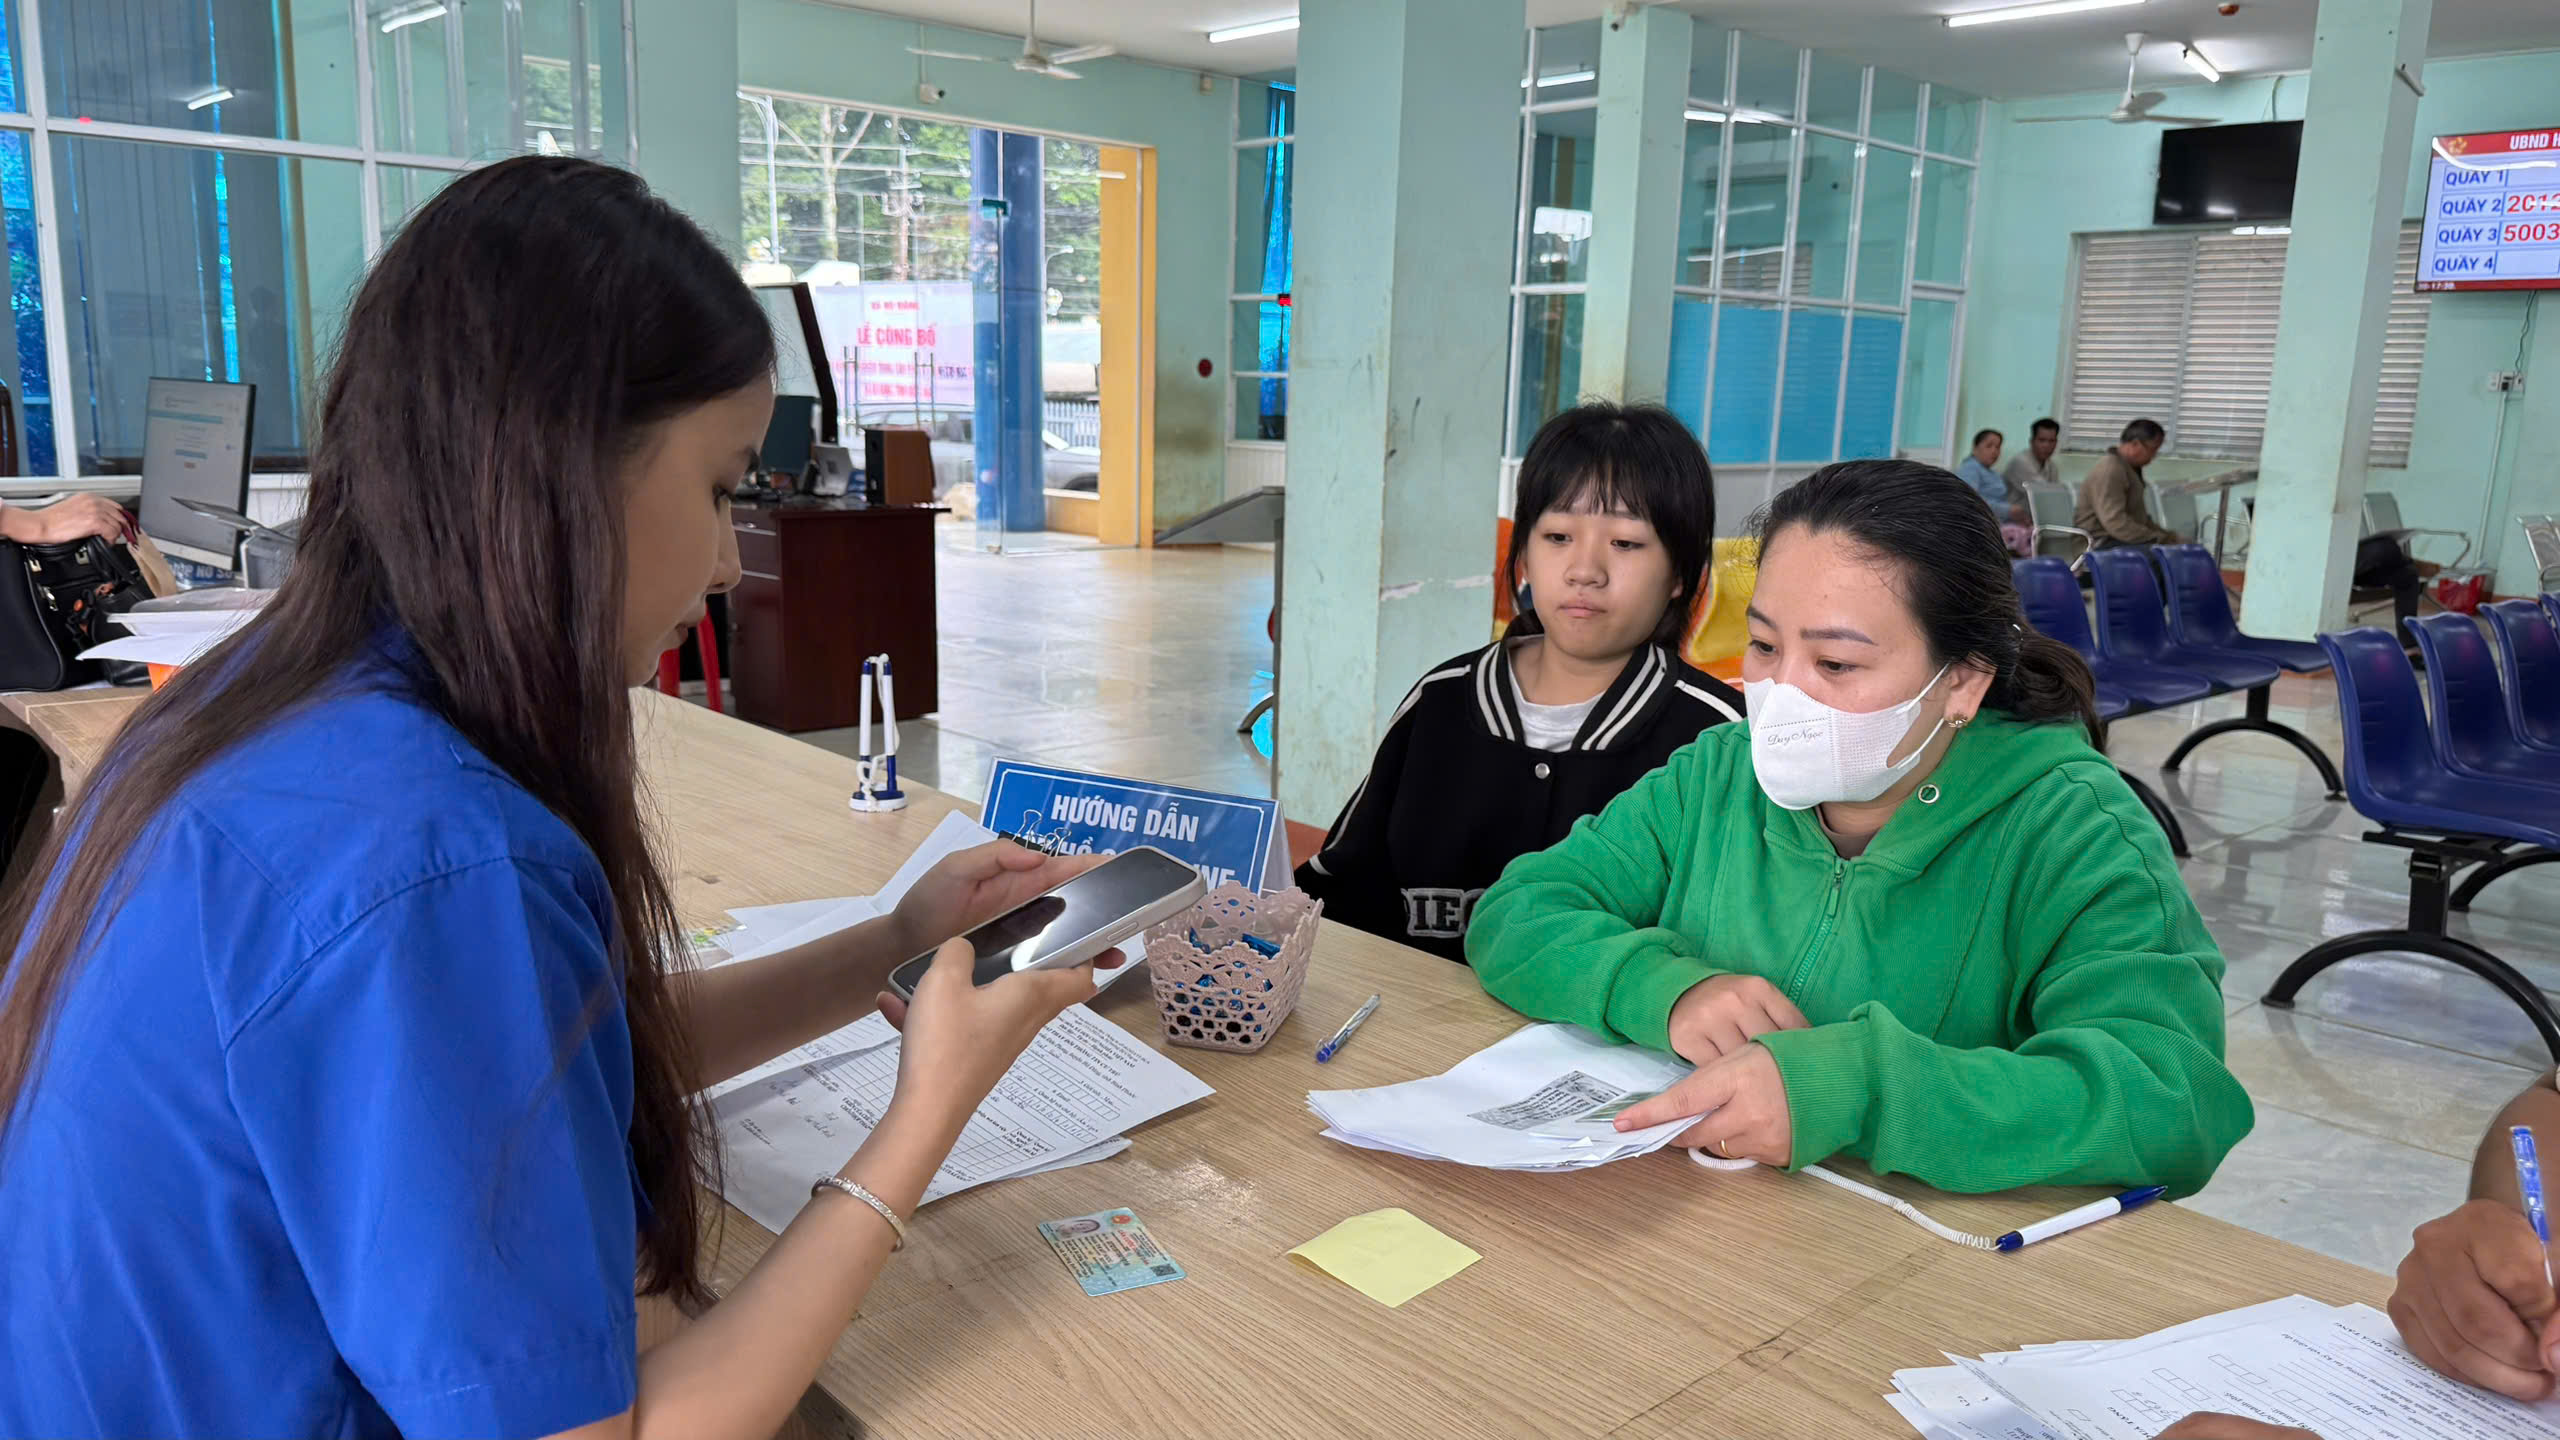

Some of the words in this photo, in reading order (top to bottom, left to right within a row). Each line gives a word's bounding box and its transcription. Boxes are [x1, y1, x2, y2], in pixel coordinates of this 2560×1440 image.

[2510, 133, 2549, 149] UBND
[2492, 199, 2501, 212] 2
[2487, 228, 2497, 241] 3
[2484, 257, 2494, 270] 4
[1051, 794, 1138, 833] HƯỚNG
[1143, 802, 1200, 843] DẪN
